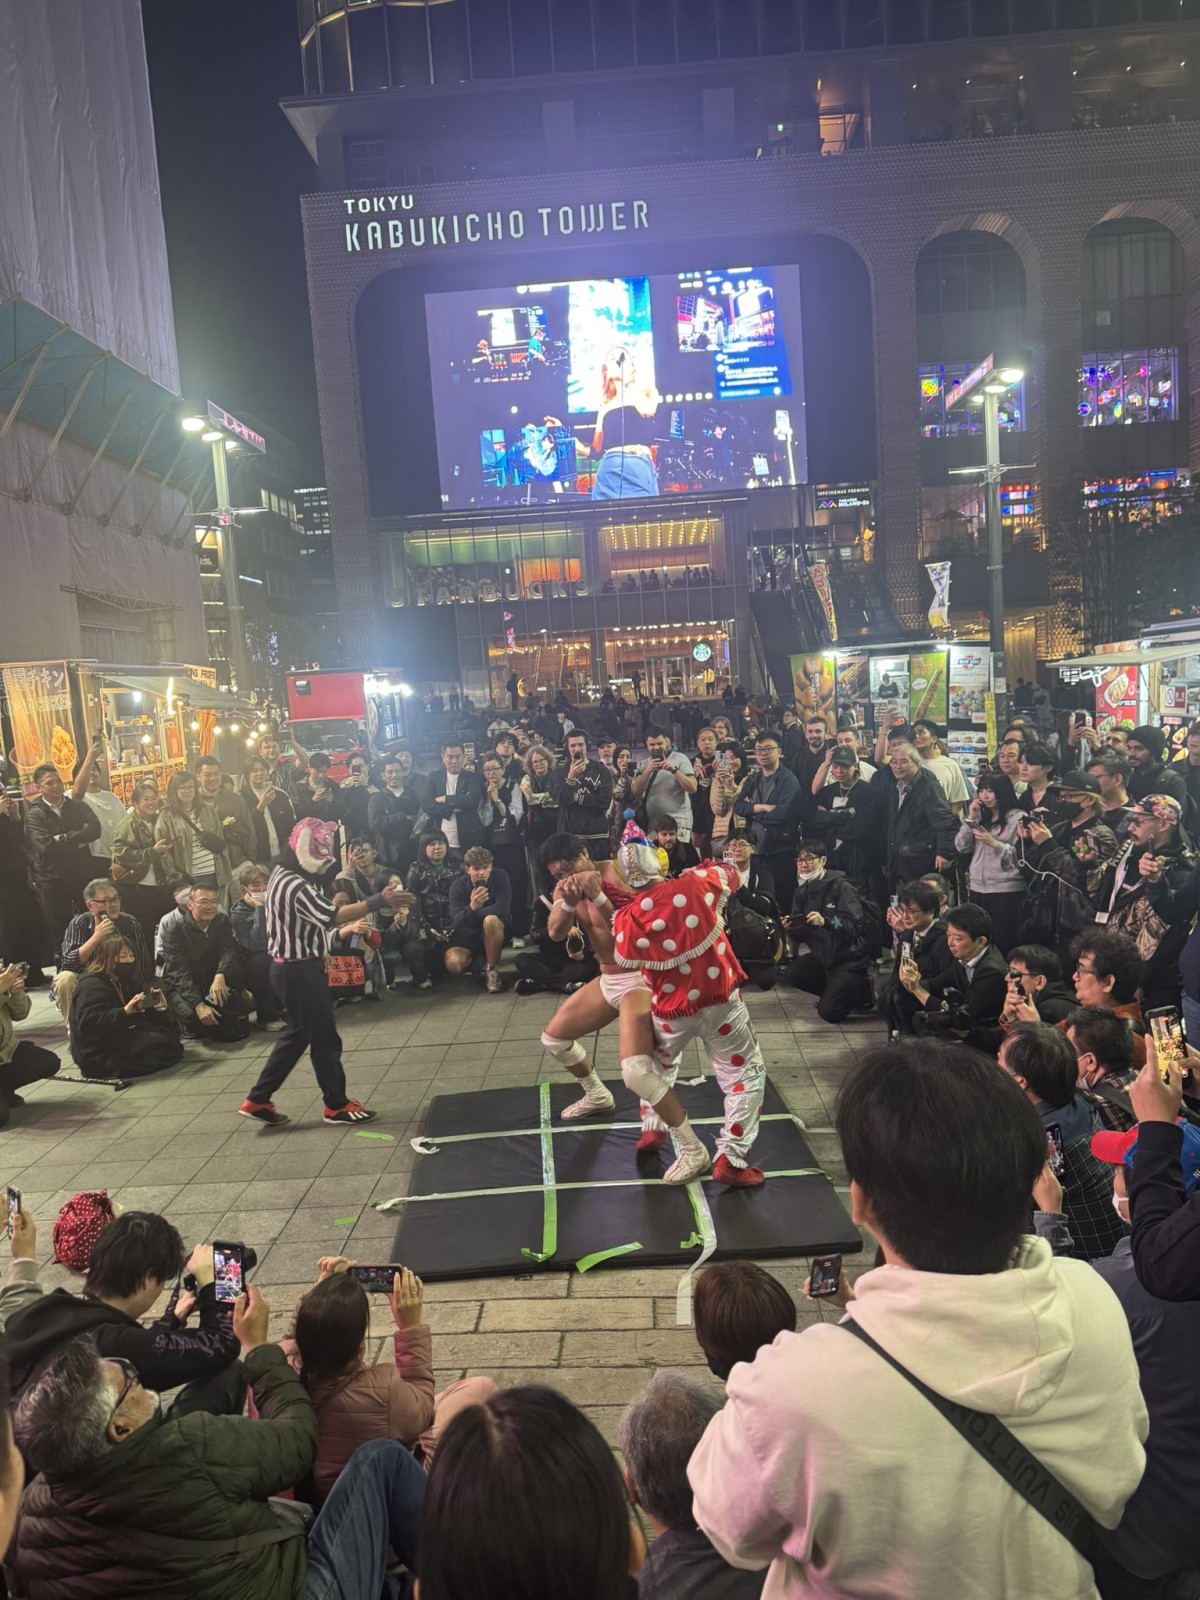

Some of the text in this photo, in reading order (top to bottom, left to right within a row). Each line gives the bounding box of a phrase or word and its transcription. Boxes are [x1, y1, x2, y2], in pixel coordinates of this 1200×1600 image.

[344, 194, 414, 214] TOKYU
[345, 200, 649, 252] KABUKICHO TOWER
[391, 577, 590, 608] STARBUCKS
